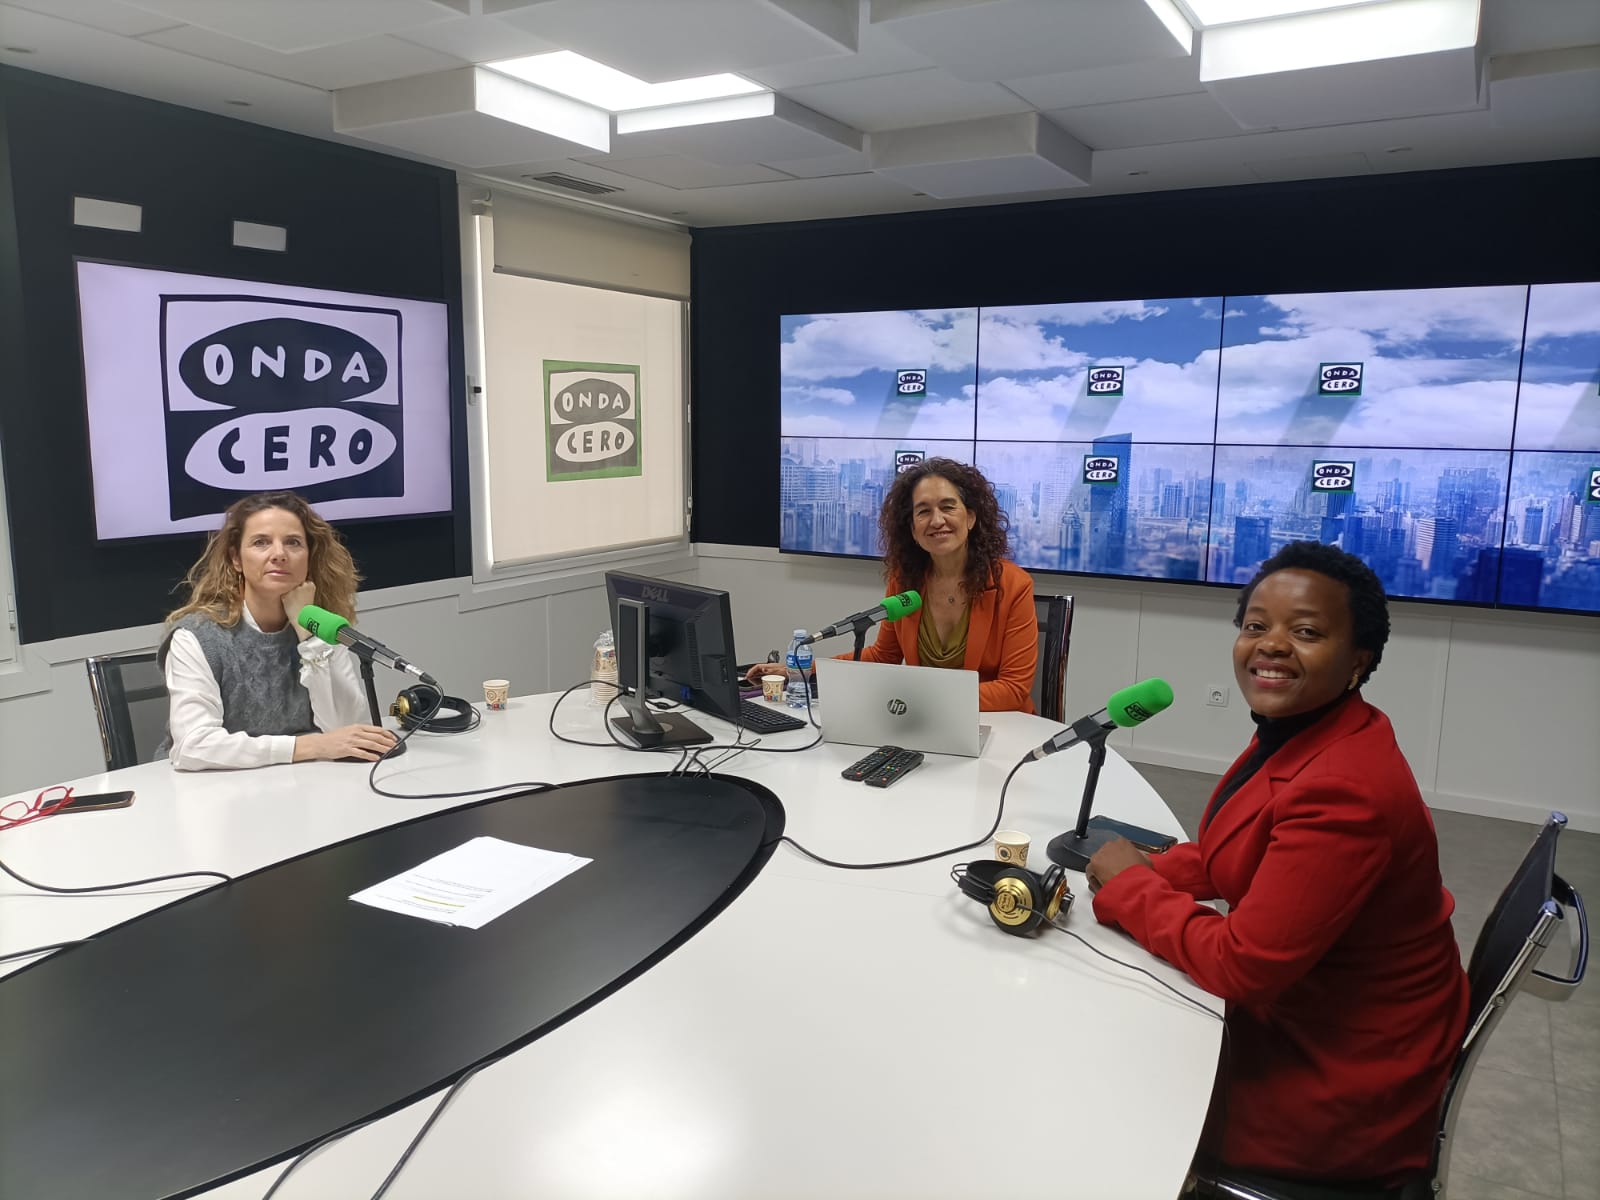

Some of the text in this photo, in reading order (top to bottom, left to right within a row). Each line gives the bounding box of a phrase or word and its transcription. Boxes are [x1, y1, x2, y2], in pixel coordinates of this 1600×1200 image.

[203, 343, 370, 385] ONDA
[1327, 381, 1354, 389] CERO
[562, 392, 624, 412] ONDA
[217, 425, 372, 474] CERO
[567, 430, 625, 454] CERO
[1090, 471, 1113, 479] CERO
[1320, 478, 1346, 486] CERO
[641, 584, 668, 602] DELL
[890, 697, 905, 715] hp
